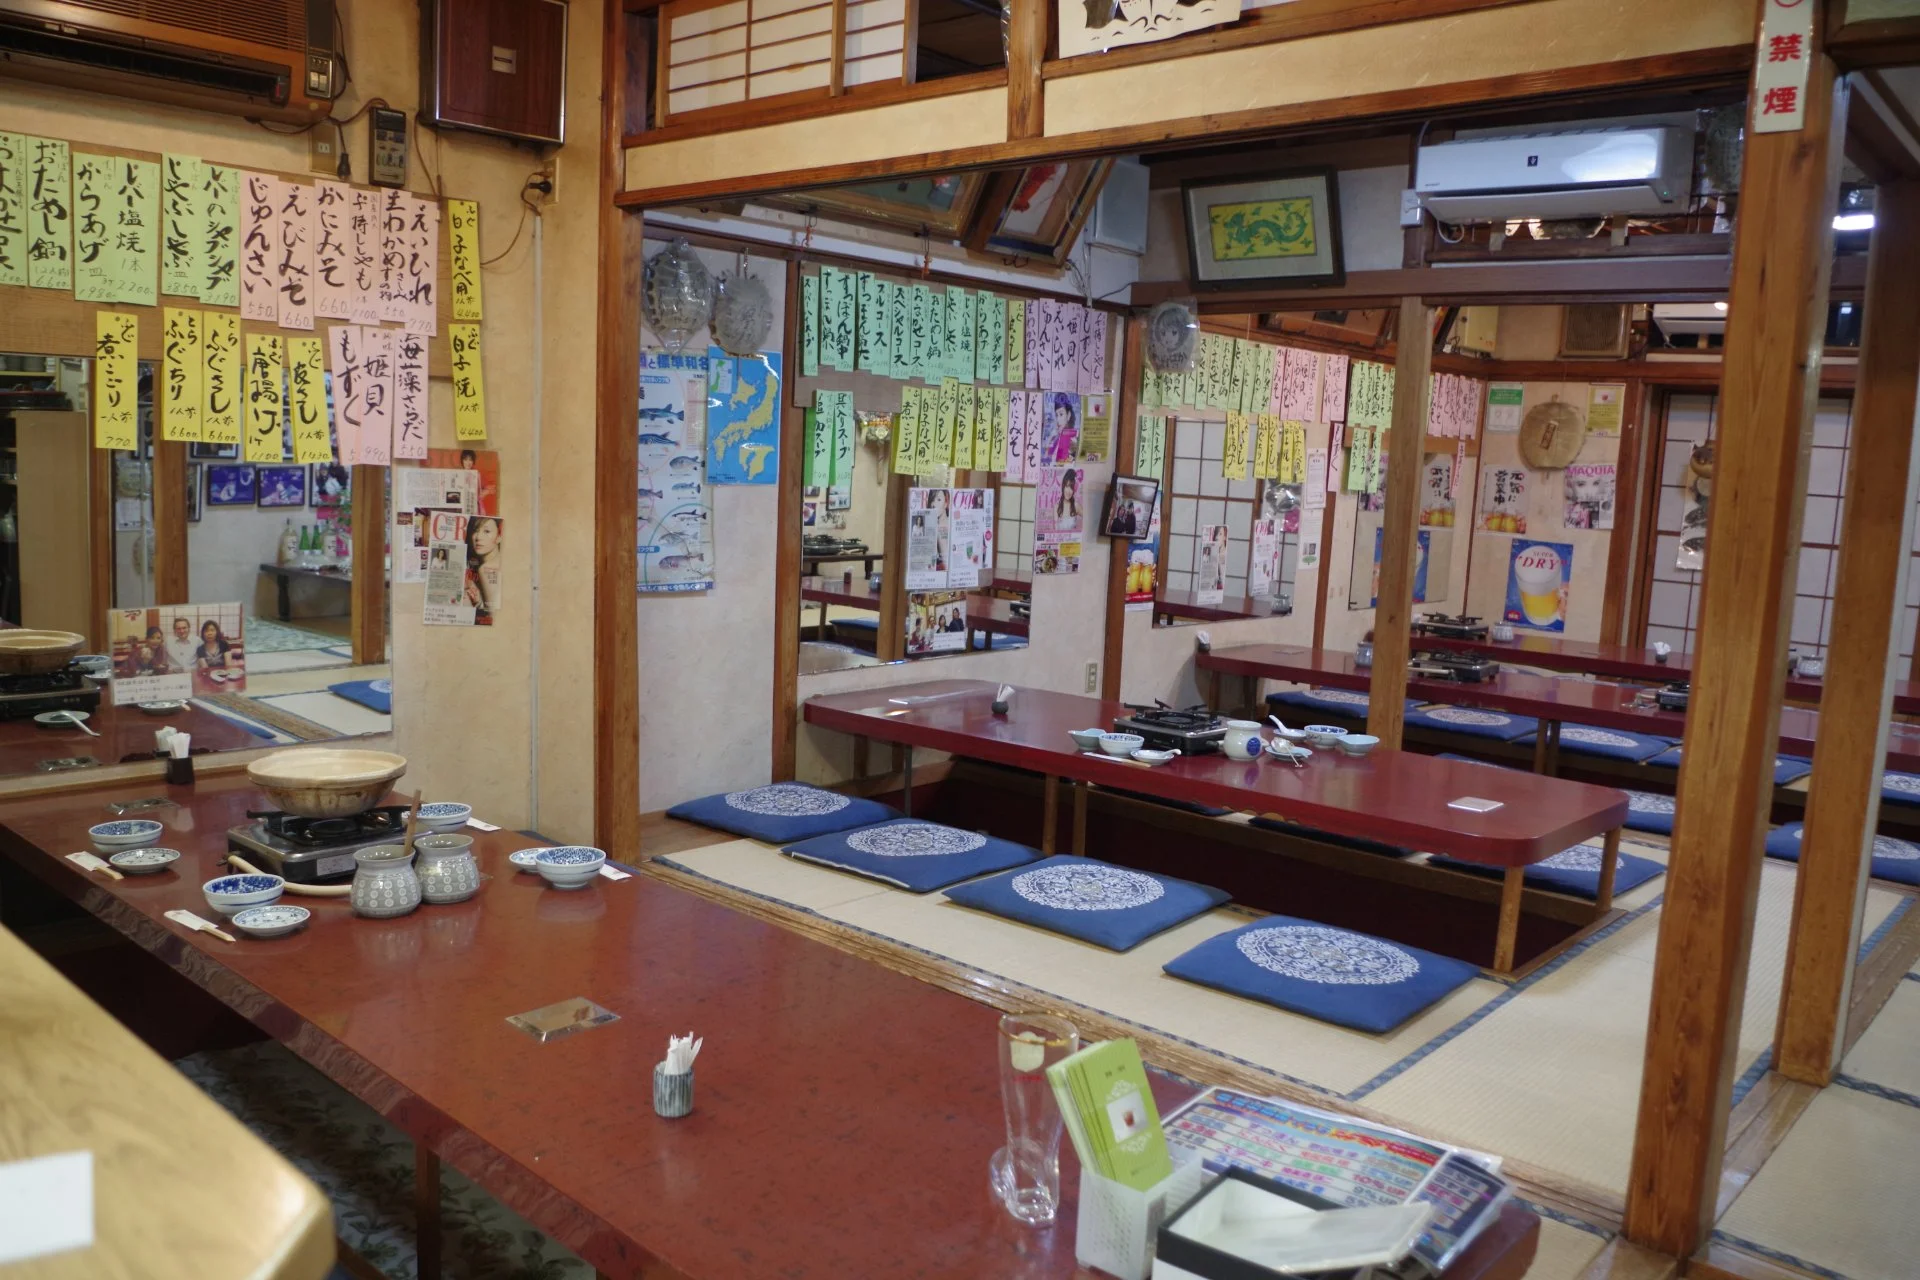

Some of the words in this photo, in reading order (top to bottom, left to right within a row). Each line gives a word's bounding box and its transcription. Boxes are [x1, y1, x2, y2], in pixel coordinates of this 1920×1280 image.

[1763, 33, 1803, 115] 禁煙
[77, 163, 110, 263] からあげ
[244, 177, 273, 294] じゅんさい
[278, 187, 310, 306] えびみそ
[316, 187, 346, 288] かにみそ
[351, 192, 375, 291] 子持ししゃも
[408, 204, 434, 307] えいひれ
[166, 320, 188, 401] ふぐちり
[874, 284, 888, 347] フルコース
[893, 287, 909, 367] スペシャルコース
[206, 329, 231, 414] ふぐさし
[250, 346, 281, 436] 唐揚げ
[337, 331, 363, 427] もずく
[1567, 465, 1615, 478] MAQUIA
